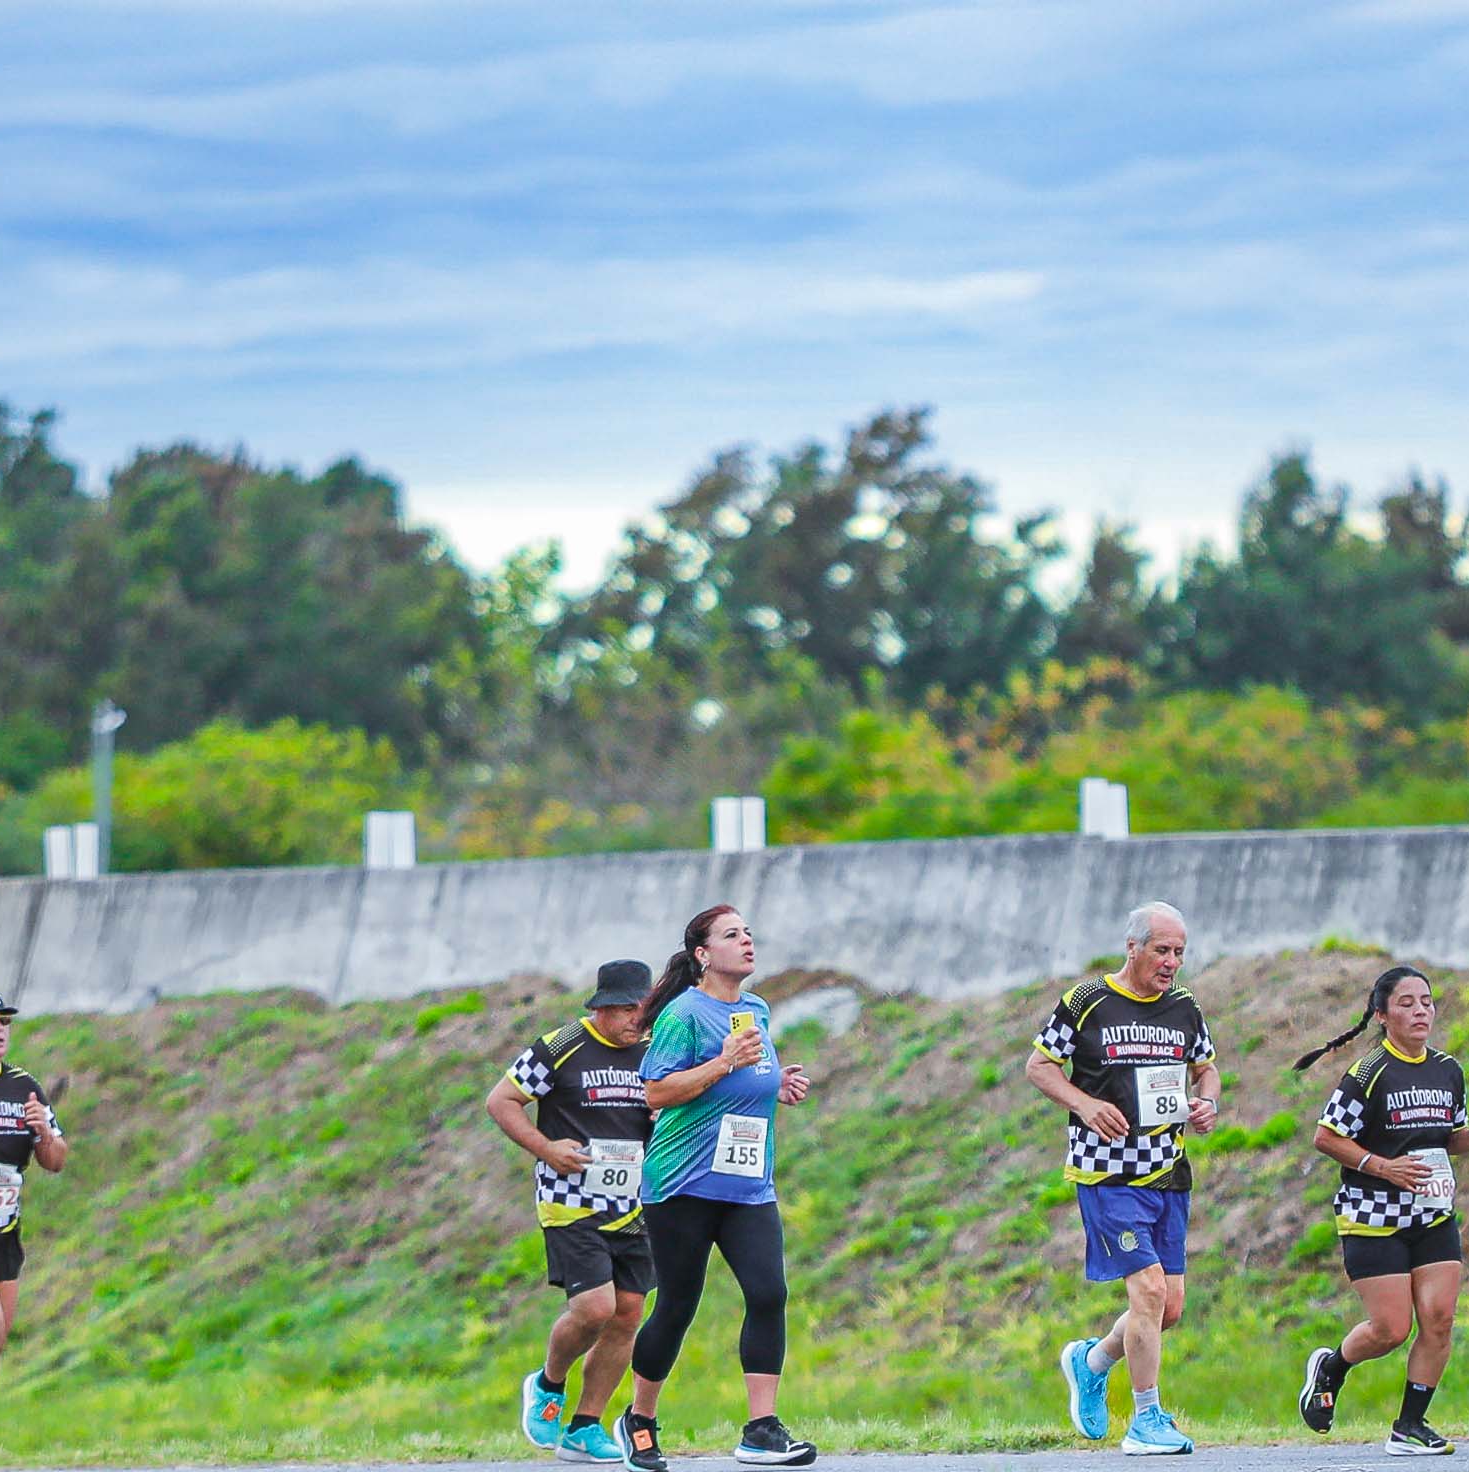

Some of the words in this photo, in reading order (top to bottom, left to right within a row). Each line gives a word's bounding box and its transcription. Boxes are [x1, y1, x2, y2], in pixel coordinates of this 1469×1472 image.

[1102, 1021, 1186, 1047] AUTÓDROMO
[1117, 1045, 1151, 1056] RUNNING
[1152, 1046, 1175, 1056] RACE
[629, 1090, 645, 1099] RAC
[1156, 1096, 1178, 1115] 89
[1400, 1108, 1430, 1121] RUNNING
[1431, 1108, 1446, 1119] RACE
[725, 1146, 757, 1166] 155
[602, 1169, 628, 1187] 80
